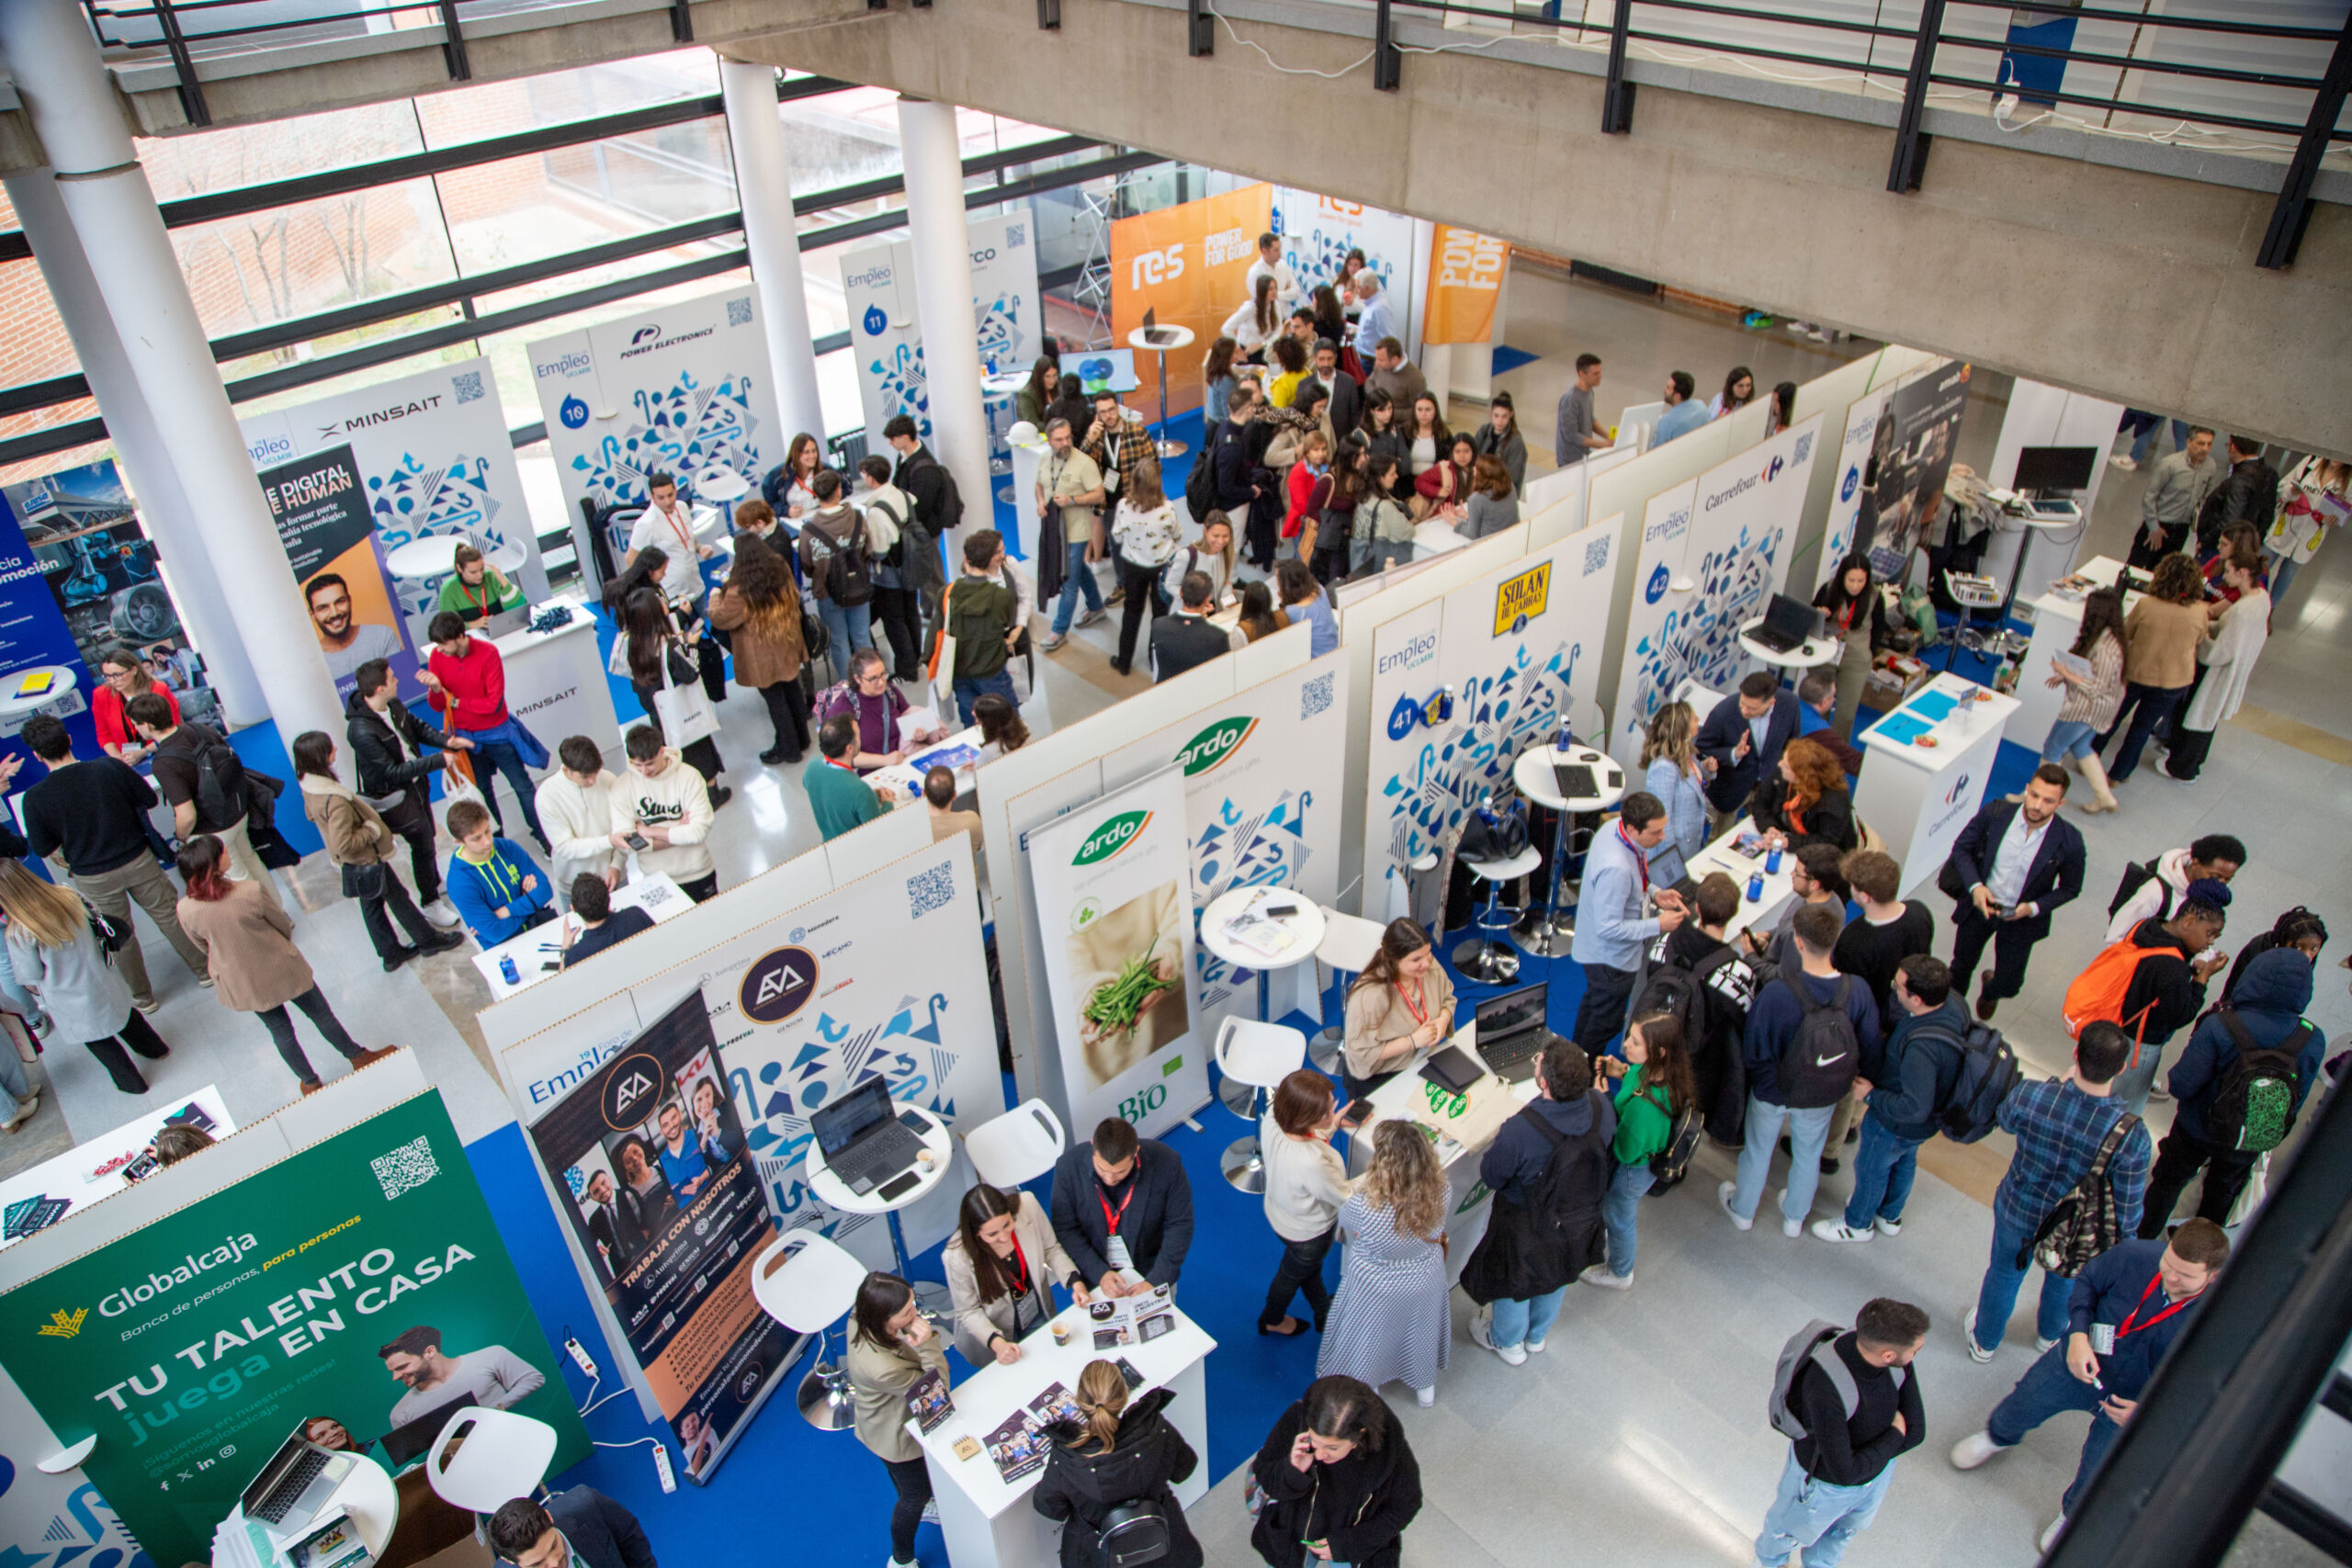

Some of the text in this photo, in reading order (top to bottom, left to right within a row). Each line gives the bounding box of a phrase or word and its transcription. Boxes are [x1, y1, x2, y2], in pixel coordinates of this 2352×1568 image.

[1204, 228, 1242, 249] POWER
[1205, 240, 1253, 268] FOR GOOD
[847, 267, 891, 288] Empleo
[1467, 234, 1504, 290] FOR
[869, 315, 881, 329] 11
[620, 327, 714, 359] POWER ELECTRONICS
[537, 353, 590, 378] Empleo
[345, 395, 441, 432] MINSAIT
[566, 407, 583, 423] 10
[280, 464, 350, 498] DIGITAL
[284, 476, 353, 510] HUMAN
[1705, 473, 1758, 512] Carrefour
[1843, 475, 1857, 493] 43
[288, 510, 316, 528] formar
[316, 502, 339, 517] parte
[301, 509, 348, 536] tecnológica
[1645, 510, 1690, 542] Empleo
[0, 558, 60, 585] moción
[1651, 574, 1668, 593] 42
[1500, 591, 1543, 620] DE CABRAS
[1379, 635, 1436, 674] Empleo
[515, 687, 578, 717] MINSAIT
[1393, 709, 1412, 730] 41
[1180, 728, 1238, 767] ardo
[1928, 797, 1970, 838] Carrefour
[1081, 821, 1136, 859] ardo
[808, 915, 840, 933] Monedero
[822, 941, 853, 959] MECANO
[579, 1051, 591, 1060] 19
[1431, 1090, 1448, 1111] ardo
[1449, 1097, 1466, 1118] ardo
[707, 1189, 735, 1222] Monedero
[621, 1236, 670, 1290] TRABAJA
[667, 1213, 691, 1242] CON
[689, 1160, 742, 1220] NOSOTROS
[652, 1237, 688, 1278] Autoprima
[98, 1233, 258, 1317] Globalcaja
[120, 1214, 362, 1342] Banca de personas, para personas
[94, 1248, 396, 1412] TU TALENTO
[122, 1243, 477, 1448] juega EN CASA
[684, 1305, 754, 1393] Tu talento es nuestro
[215, 1416, 233, 1429] en
[235, 1382, 295, 1419] nuestras
[297, 1359, 337, 1385] redes!
[149, 1403, 279, 1478] @somosglobalcaja
